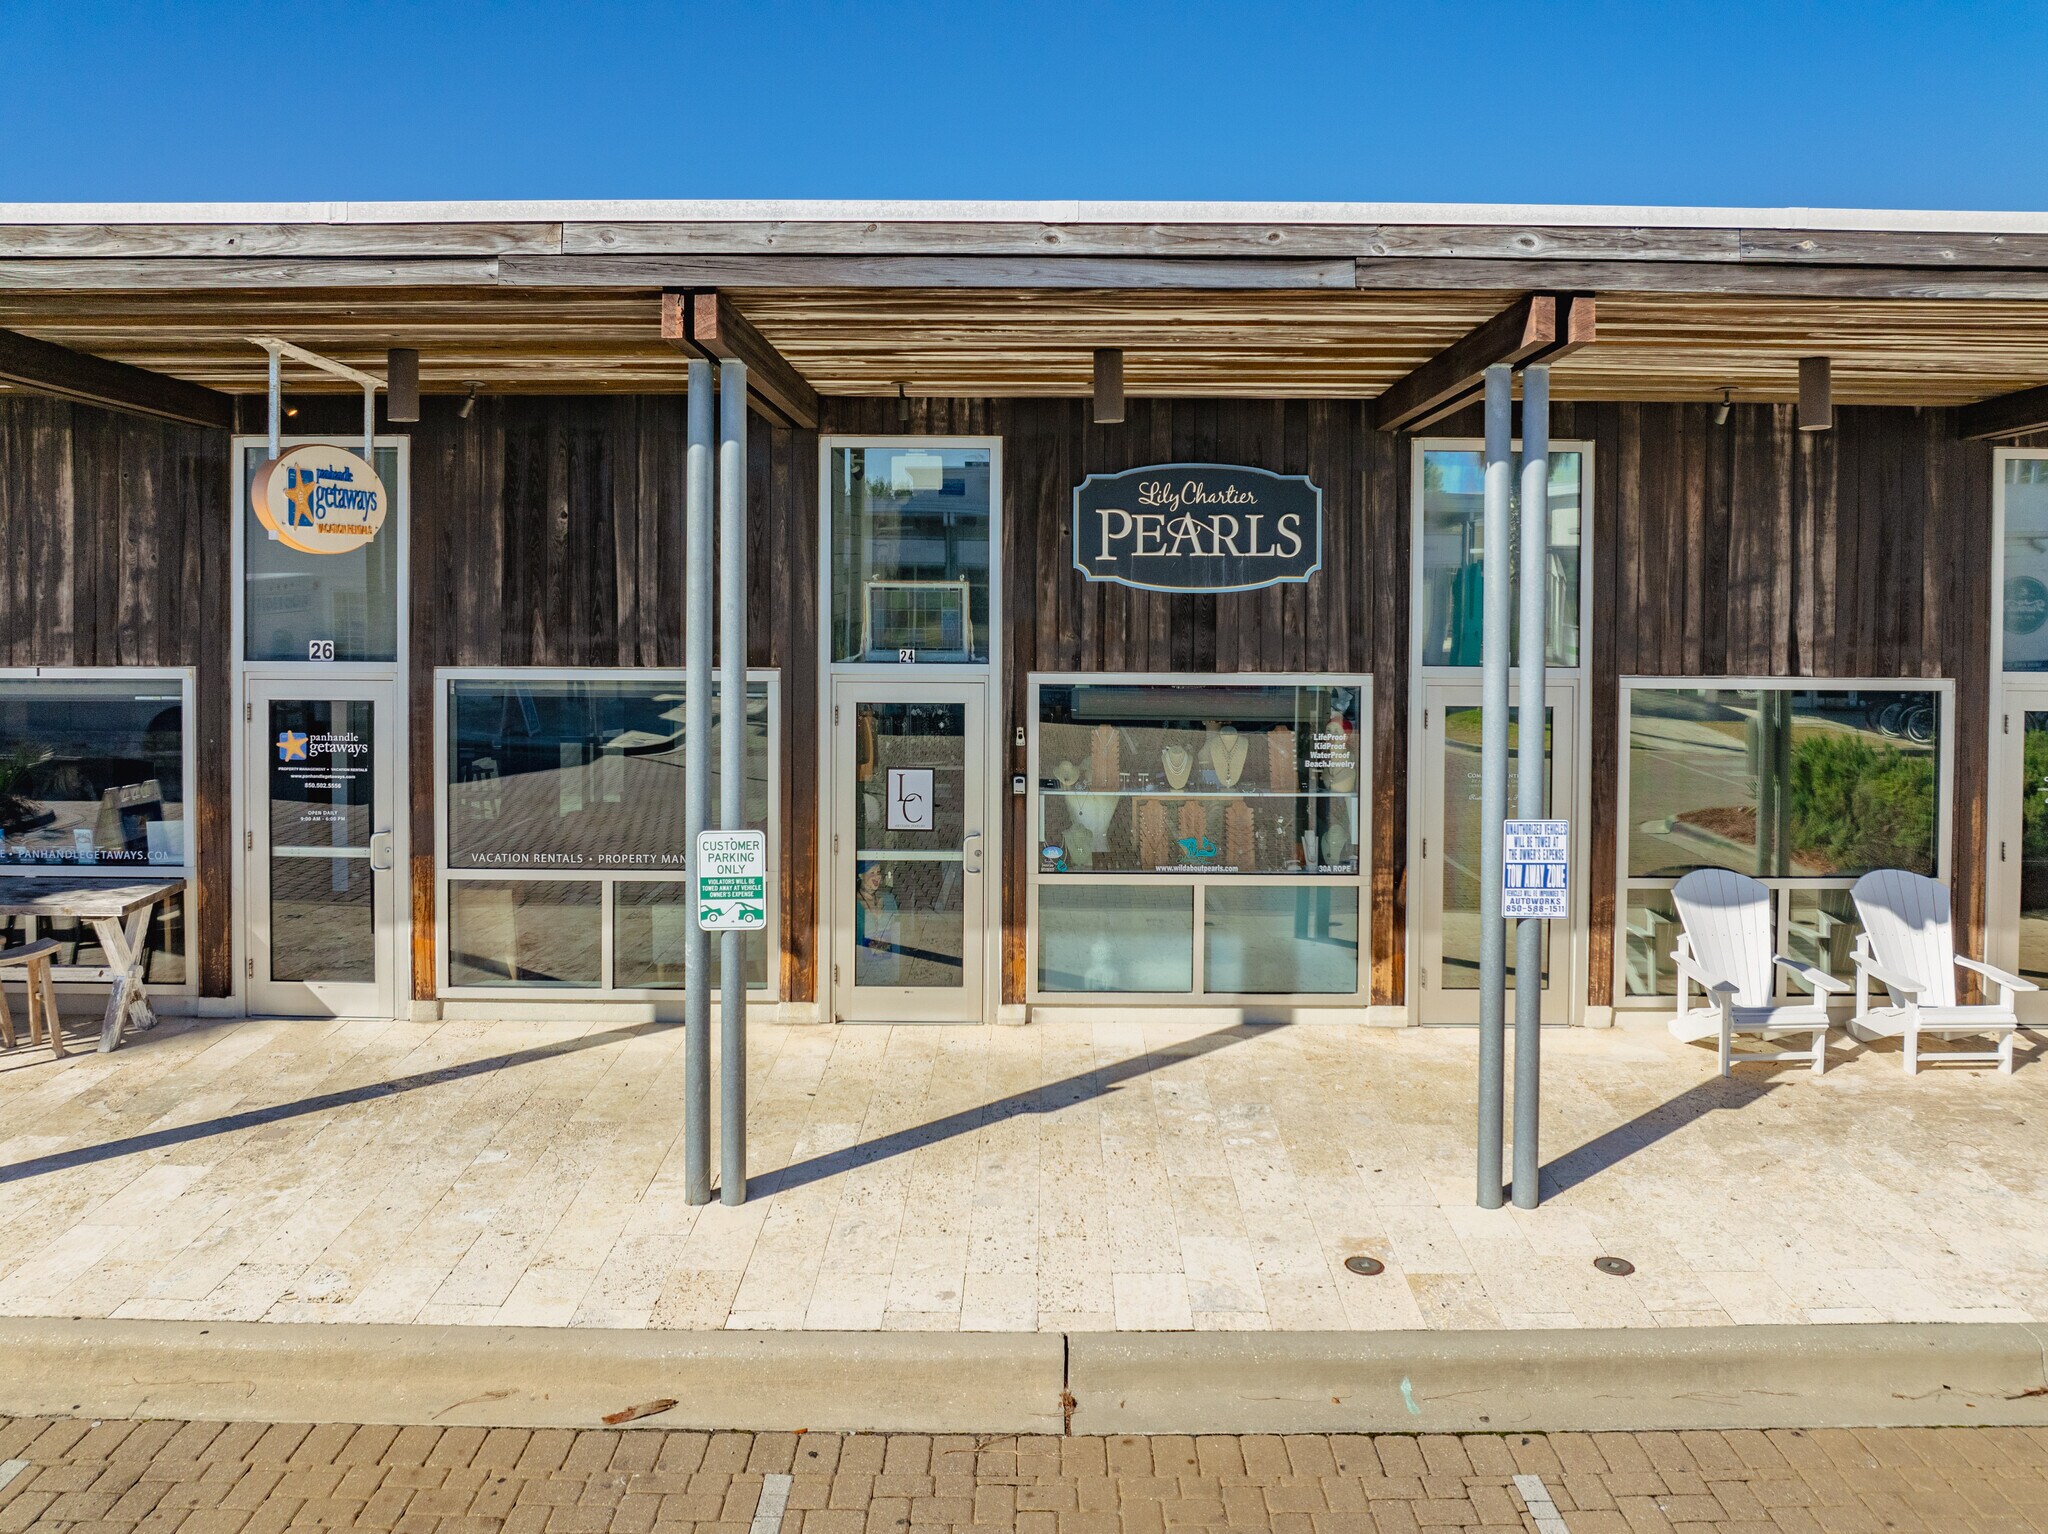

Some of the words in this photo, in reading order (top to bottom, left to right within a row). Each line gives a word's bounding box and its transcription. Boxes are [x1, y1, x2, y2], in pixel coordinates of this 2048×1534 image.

[1138, 481, 1180, 511] Lily
[1181, 480, 1258, 504] Chartier
[316, 484, 377, 521] getaways
[1095, 508, 1302, 560] PEARLS
[311, 642, 332, 659] 26
[900, 650, 914, 663] 24
[310, 732, 359, 743] panhandle
[1313, 733, 1347, 741] LifeProof
[309, 742, 368, 757] getaways
[1310, 751, 1350, 759] WaterProof
[1304, 760, 1355, 769] BeachJewelry
[1506, 824, 1542, 835] UNAUTHORIZED
[1544, 824, 1567, 835] VEHICLES
[702, 841, 760, 851] CUSTOMER
[1514, 836, 1525, 847] WILL
[1526, 836, 1533, 847] BE
[1535, 836, 1551, 847] TOWED
[1553, 836, 1559, 847] AT
[471, 853, 529, 863] VACATION
[533, 853, 583, 863] RENTALS
[598, 854, 657, 864] PROPERTY
[707, 852, 755, 862] PARKING
[1508, 849, 1517, 860] THE
[1519, 849, 1541, 860] OWNER'S
[1543, 849, 1564, 860] EXPENSE
[717, 865, 746, 874] ONLY
[1155, 865, 1238, 873] www.wildaboutpearls.com
[1506, 864, 1523, 888] TOW
[1524, 864, 1545, 888] AWAY
[1546, 864, 1566, 888] ZONE
[1505, 905, 1565, 913] 850-588-1511
